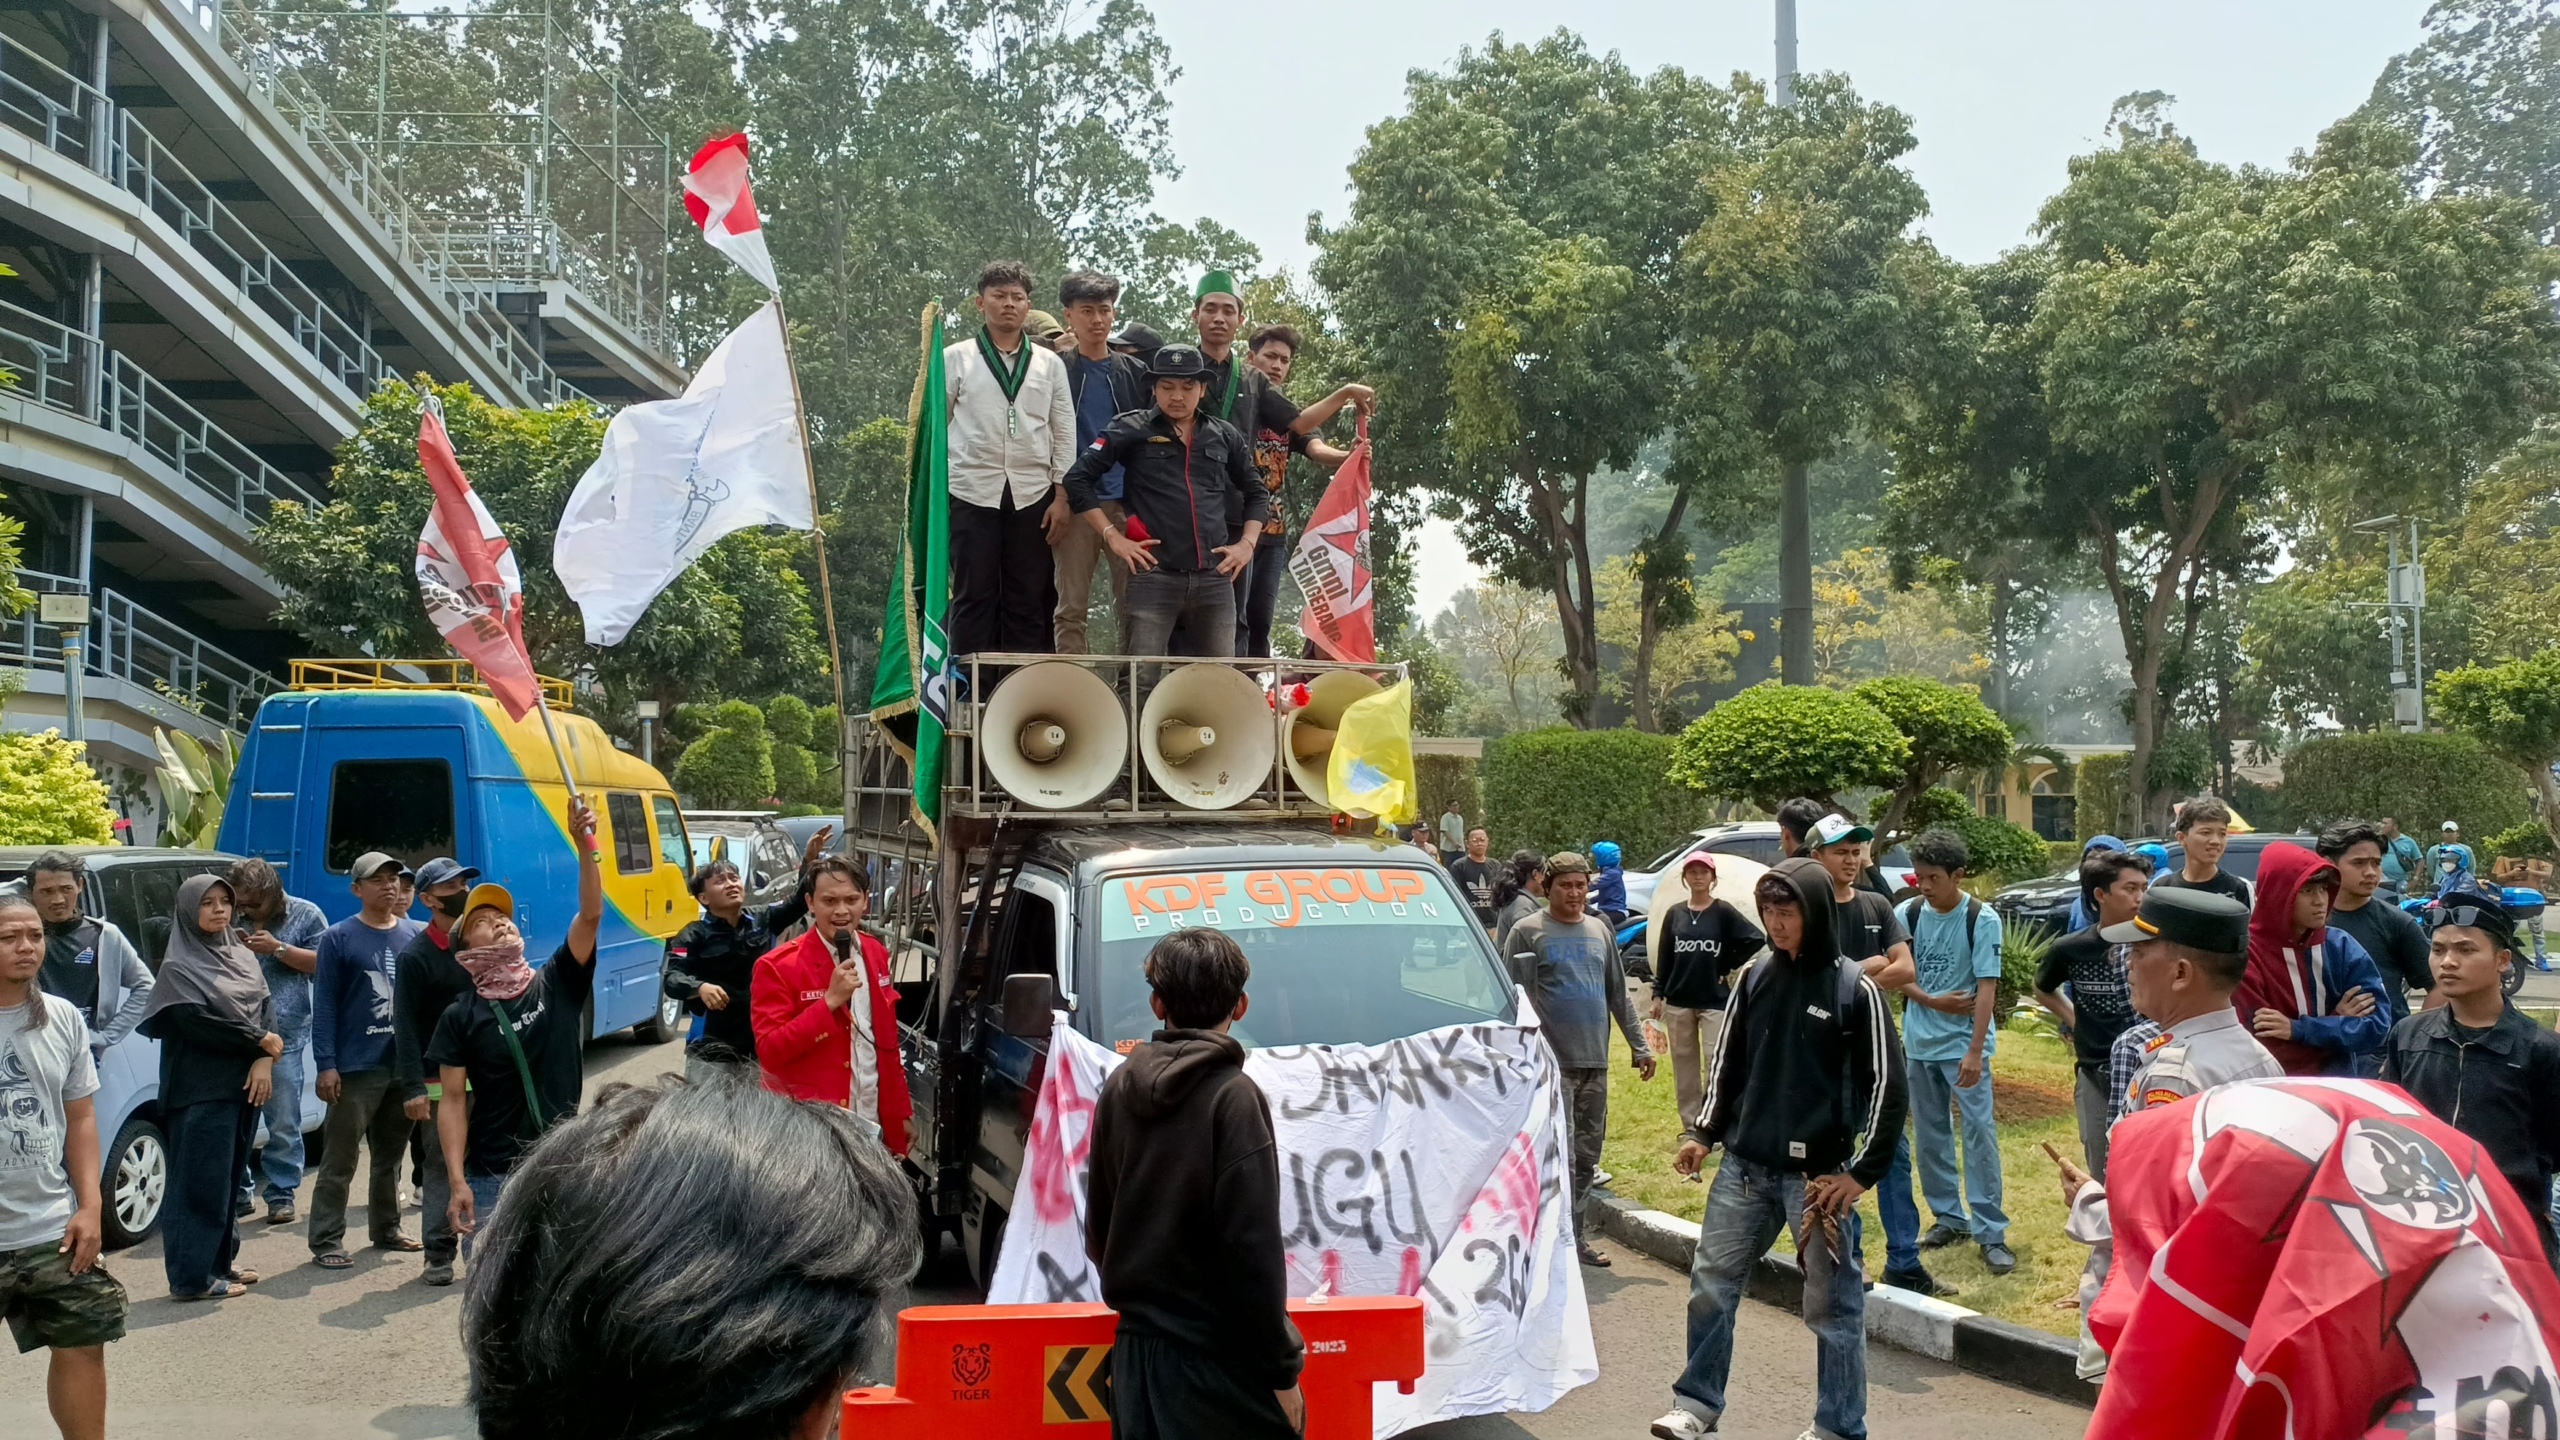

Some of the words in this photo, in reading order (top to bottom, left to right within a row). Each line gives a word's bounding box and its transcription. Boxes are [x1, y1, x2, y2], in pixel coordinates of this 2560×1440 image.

[1039, 788, 1063, 797] KDF
[1123, 872, 1228, 915] KDF
[1244, 868, 1424, 928] GROUP
[1132, 901, 1438, 932] PRODUCTION
[806, 991, 824, 999] KETU
[1311, 1339, 1347, 1354] 2025
[951, 1388, 991, 1401] TIGER
